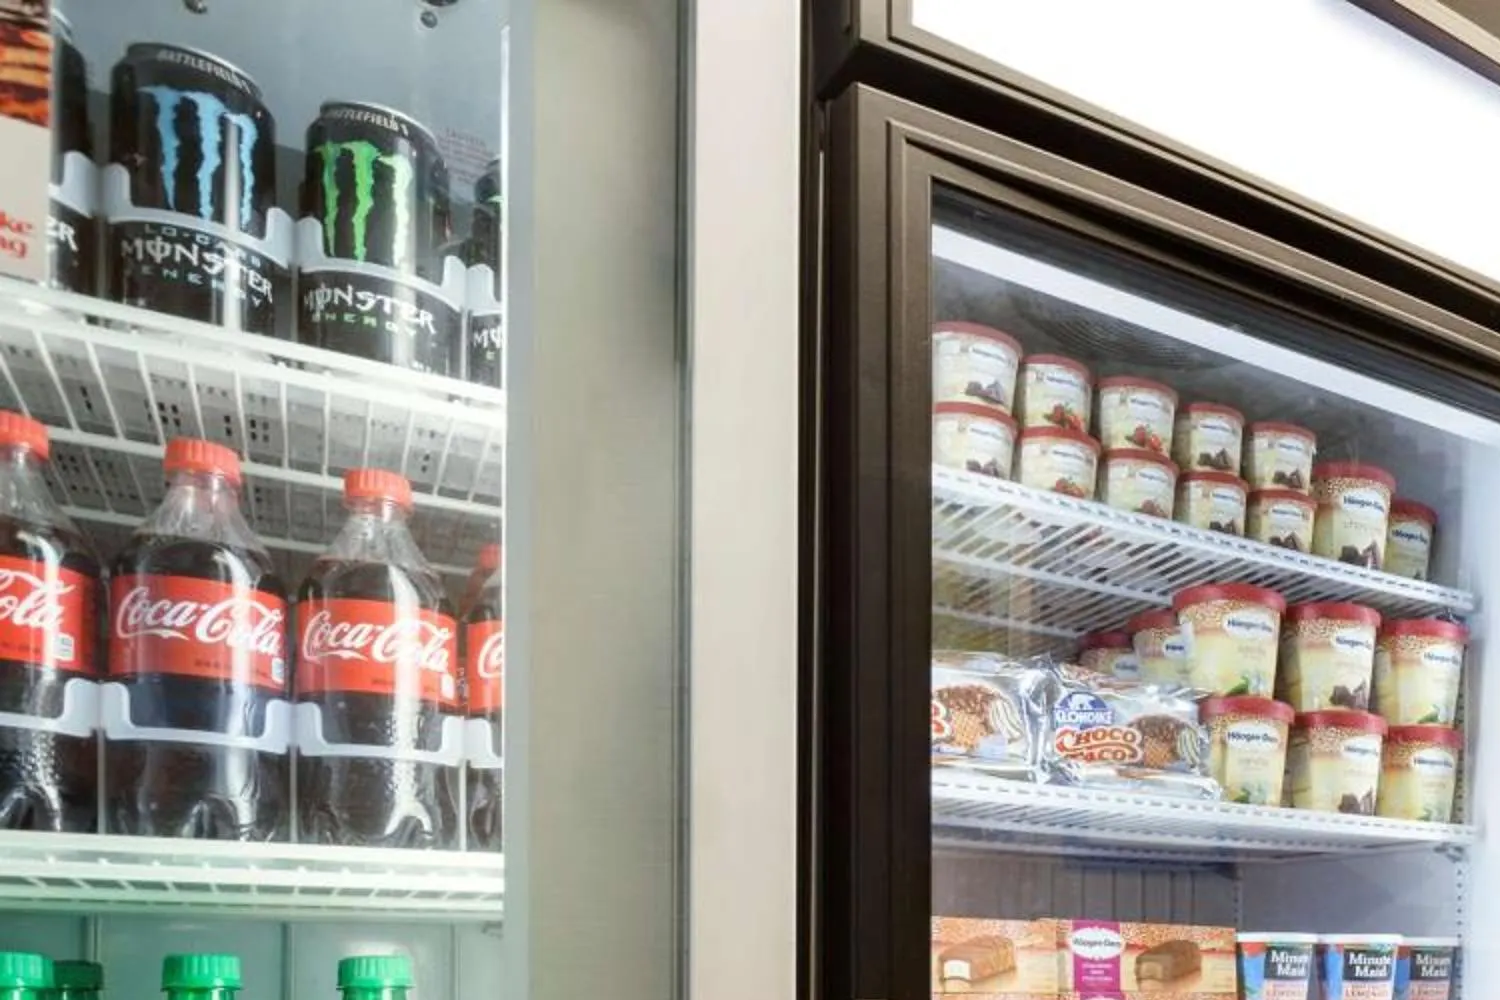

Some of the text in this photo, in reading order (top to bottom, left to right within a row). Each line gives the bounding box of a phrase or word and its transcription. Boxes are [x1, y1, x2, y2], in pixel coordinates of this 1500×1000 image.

[116, 586, 283, 655] Coca-Cola
[303, 610, 454, 674] Coca-Cola
[1354, 966, 1388, 978] Maid
